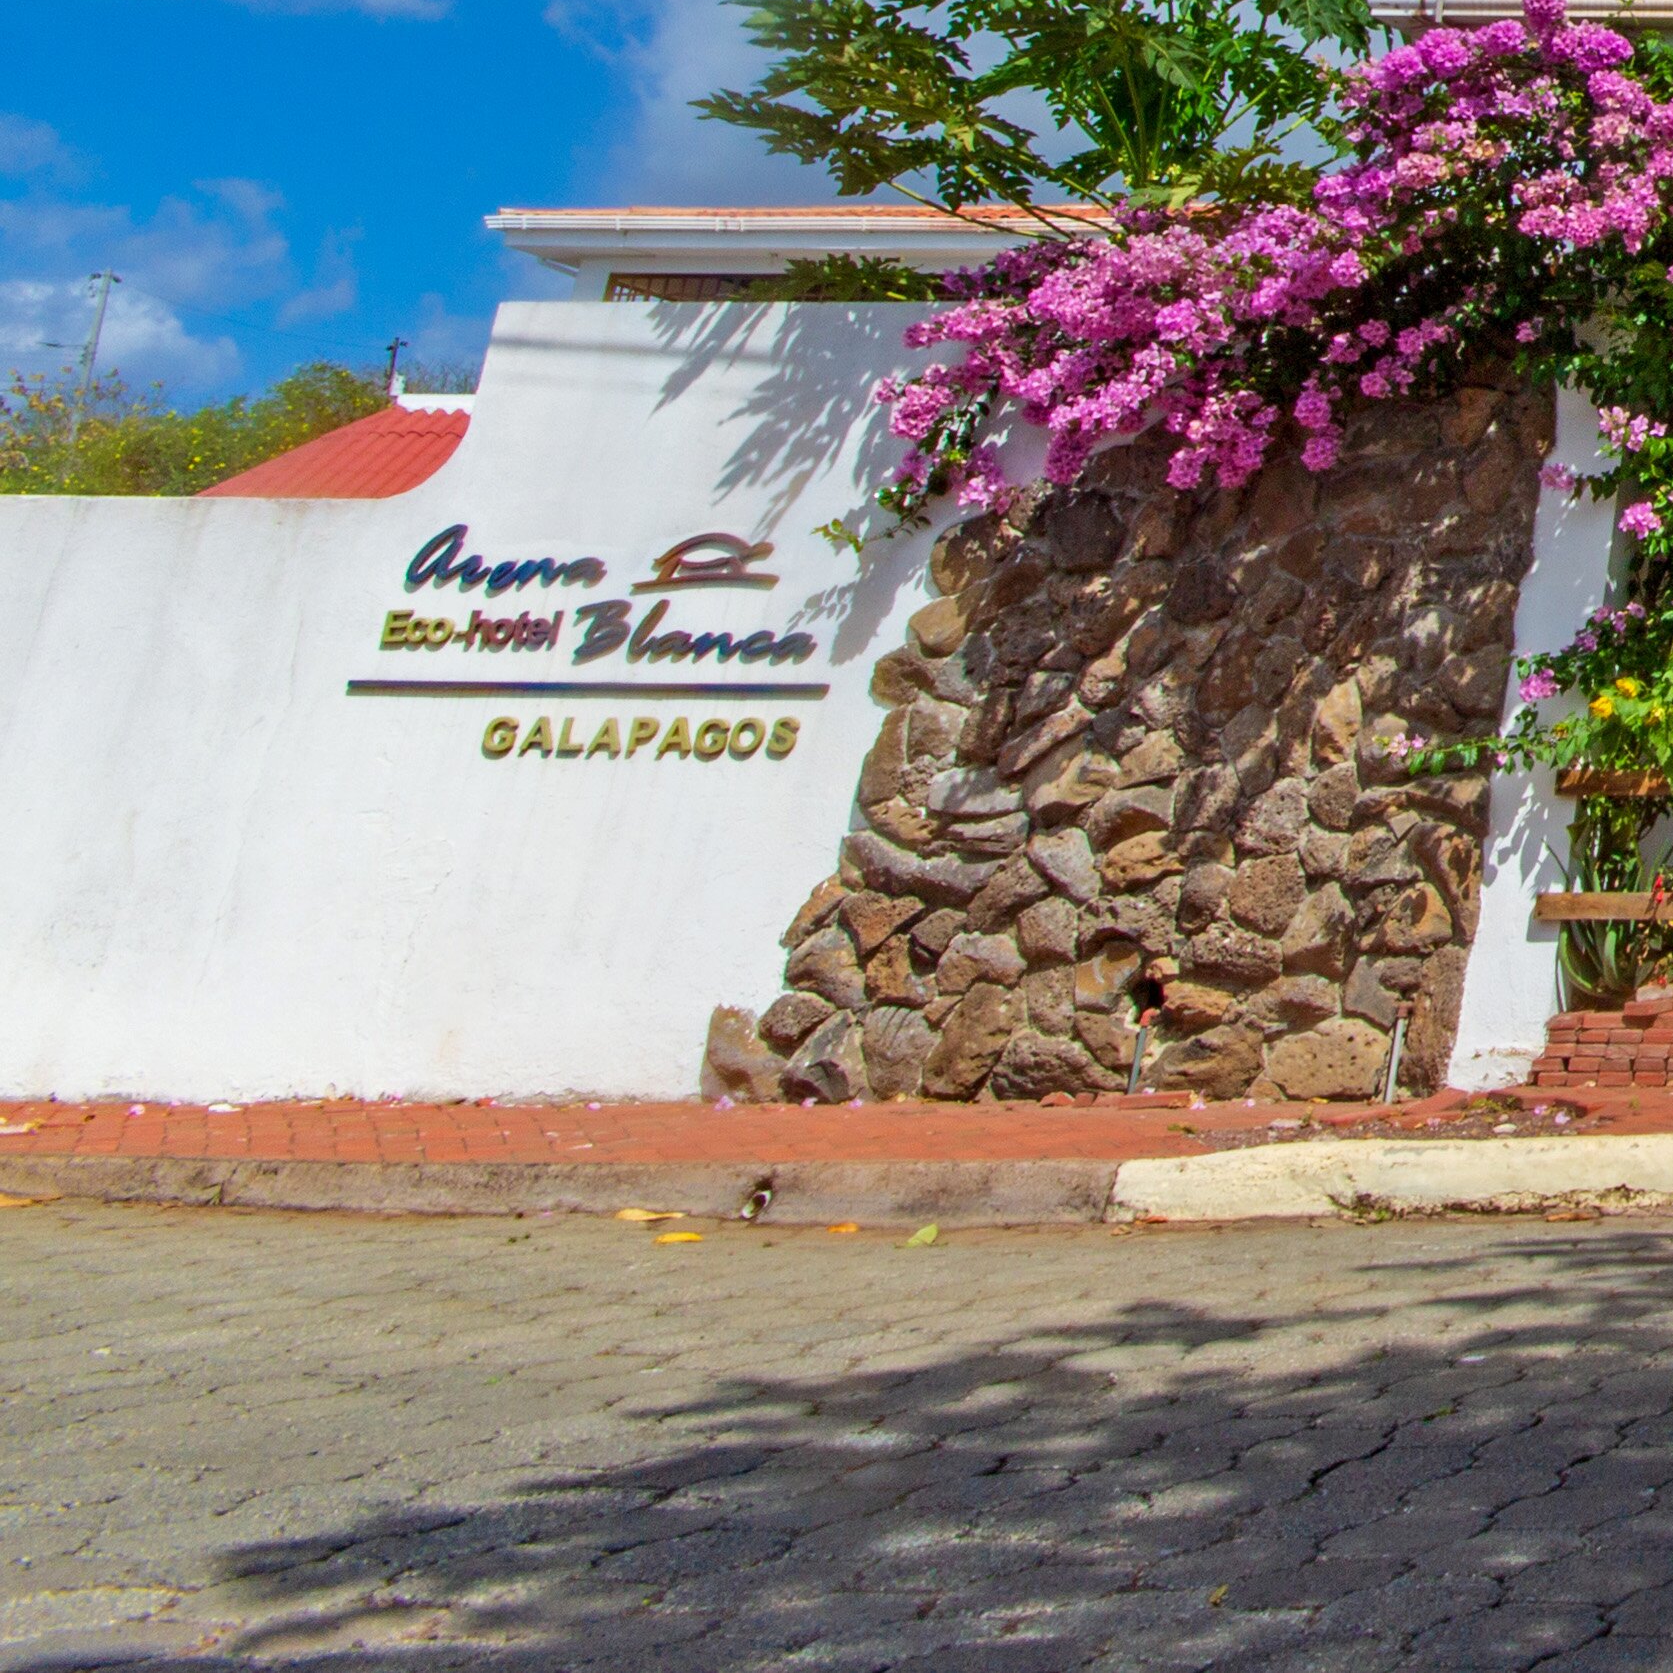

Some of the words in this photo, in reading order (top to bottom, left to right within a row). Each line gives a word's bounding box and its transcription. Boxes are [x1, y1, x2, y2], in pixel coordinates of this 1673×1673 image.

[405, 524, 606, 592] Arena
[381, 610, 563, 651] Eco-hotel
[573, 600, 816, 665] Blanca
[483, 716, 800, 761] GALAPAGOS
